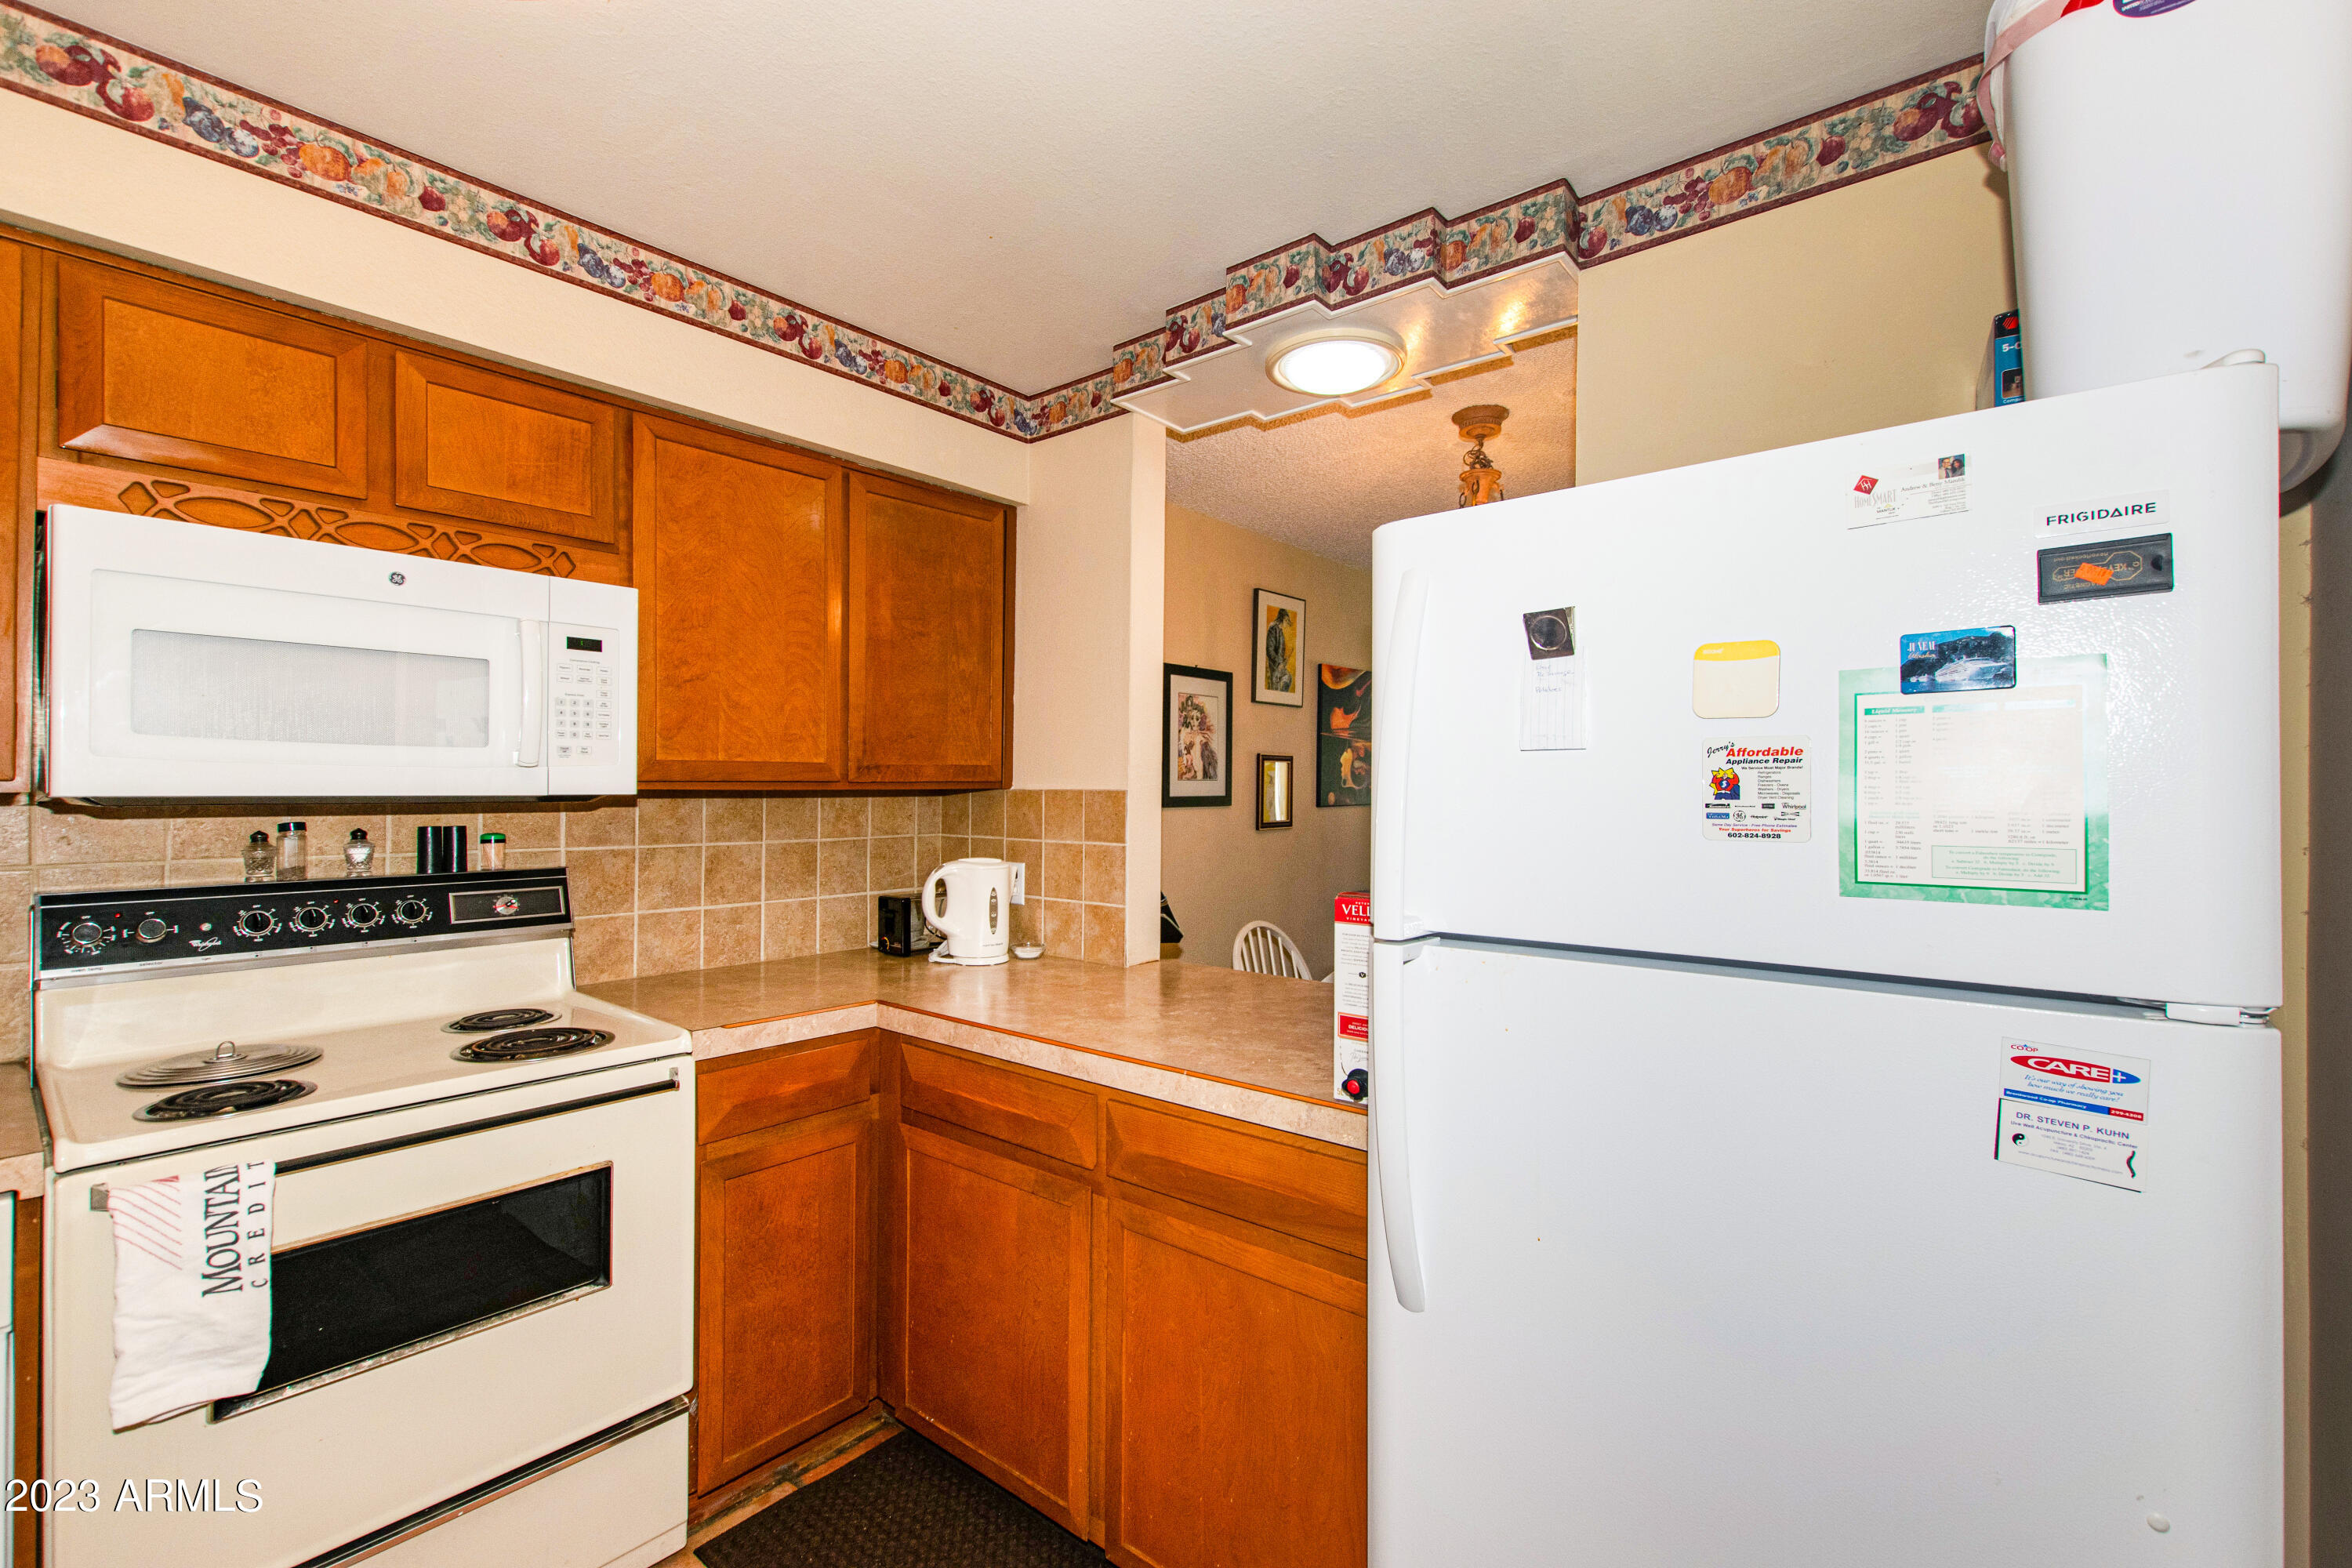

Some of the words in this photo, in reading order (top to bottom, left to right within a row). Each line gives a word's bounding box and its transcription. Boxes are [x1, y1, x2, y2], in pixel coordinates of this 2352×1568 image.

[2046, 502, 2157, 526] FRIGIDAIRE
[2063, 581, 2100, 590] AGNETIC
[1707, 741, 1735, 758] Jerry's
[1726, 746, 1804, 757] Affordable
[2067, 1081, 2076, 1090] of
[2016, 1111, 2034, 1122] DR.
[2037, 1115, 2080, 1131] STEVEN
[2082, 1123, 2093, 1133] P.
[2096, 1127, 2130, 1140] KUHN
[2035, 1125, 2072, 1138] Acupuncture
[2079, 1134, 2116, 1147] Chiropractic
[2117, 1141, 2138, 1149] Center
[247, 1160, 267, 1289] CREDIT
